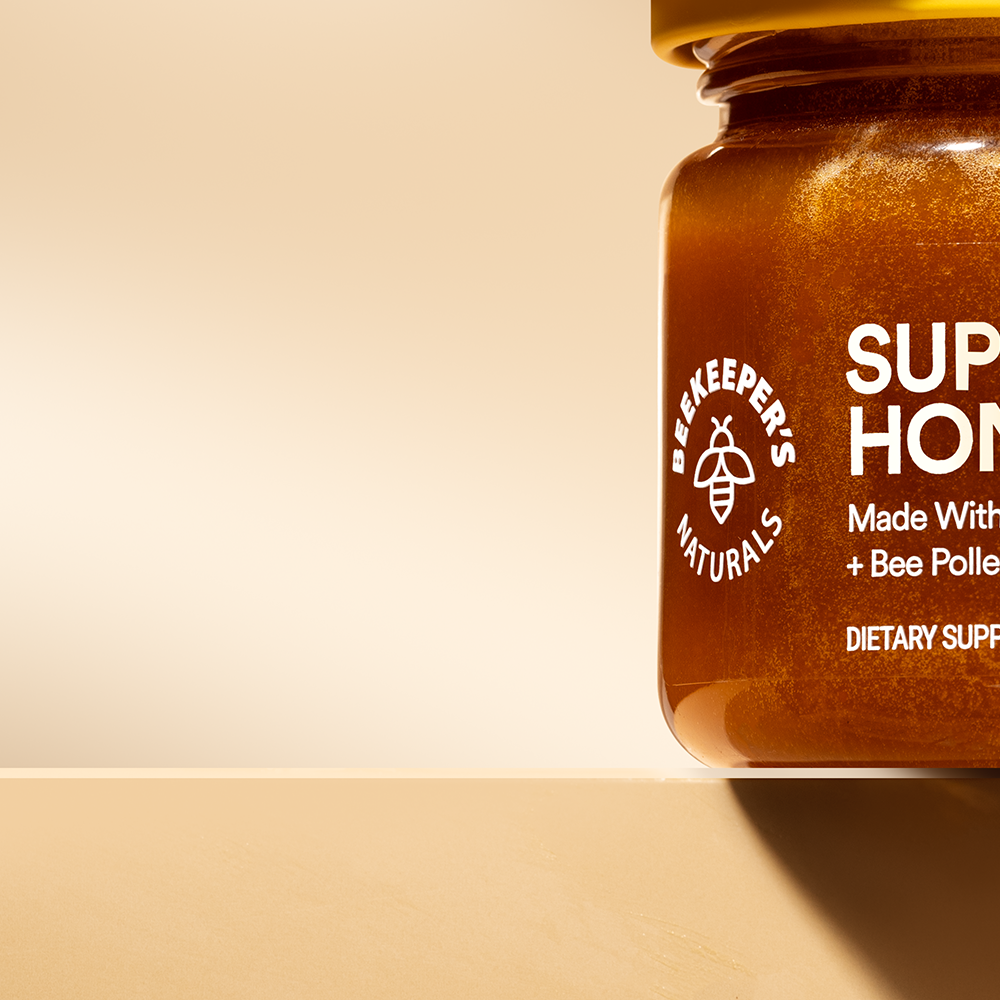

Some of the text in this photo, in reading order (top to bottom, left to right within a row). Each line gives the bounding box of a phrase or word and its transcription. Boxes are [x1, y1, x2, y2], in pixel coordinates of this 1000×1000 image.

[672, 357, 796, 475] BEEKEEPER'S
[848, 501, 928, 533] Made
[676, 507, 783, 583] NATURALS
[846, 556, 864, 577] +
[871, 548, 924, 578] Bee
[846, 624, 938, 652] DIETARY
